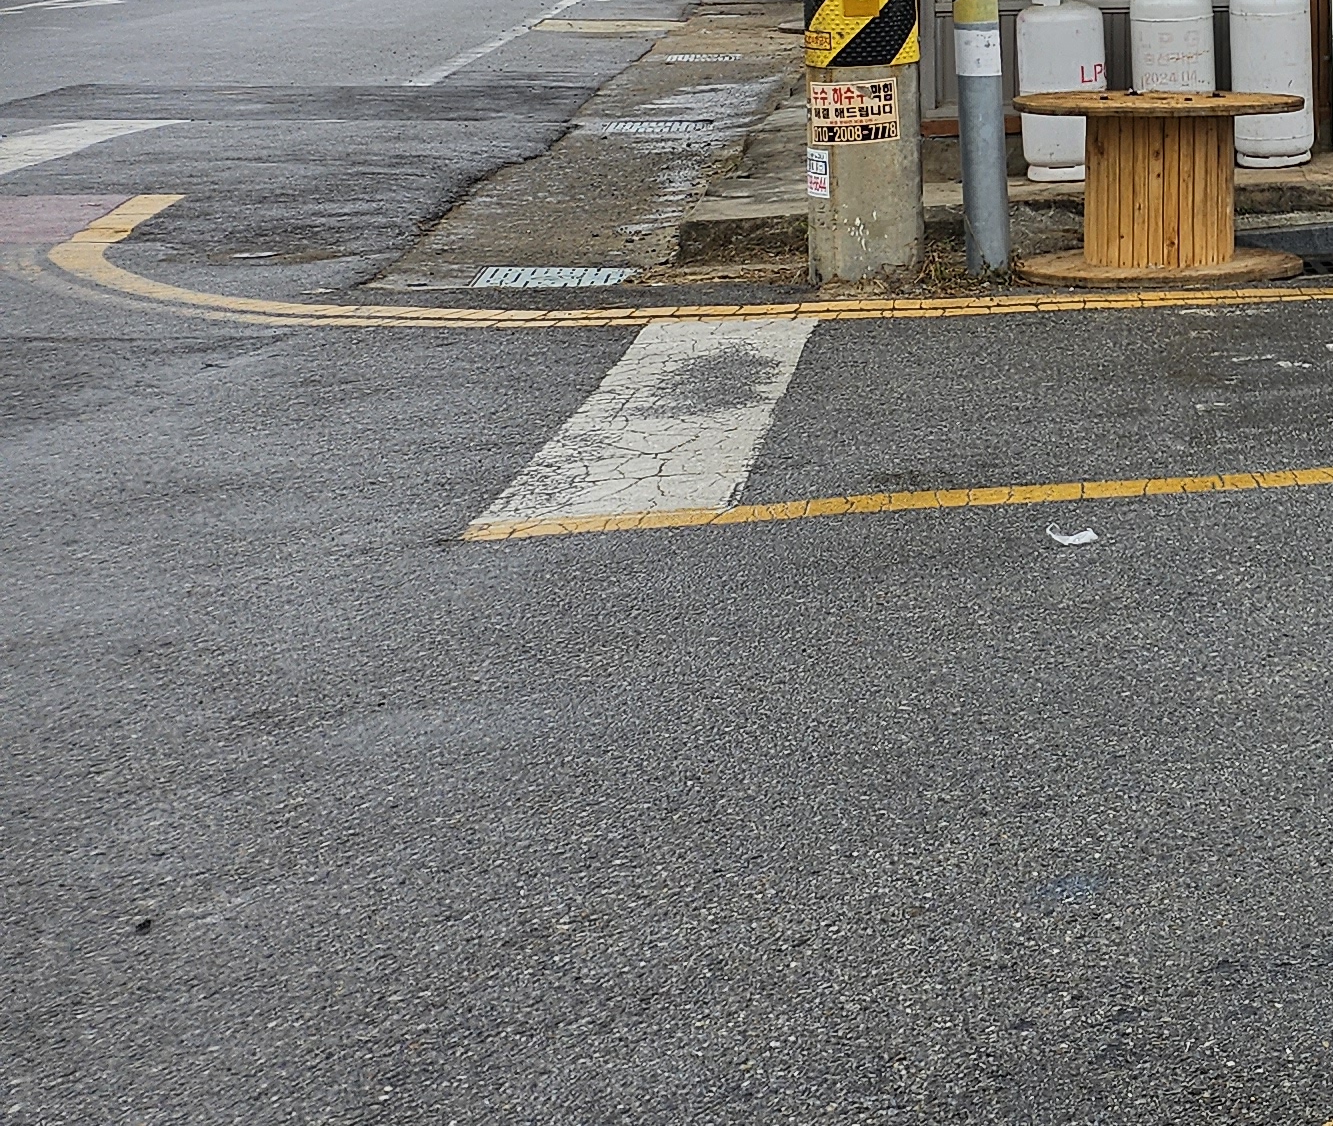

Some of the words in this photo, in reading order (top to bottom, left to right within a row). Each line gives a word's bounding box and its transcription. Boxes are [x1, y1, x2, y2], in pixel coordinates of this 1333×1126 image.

[1080, 64, 1107, 84] LP
[870, 83, 893, 102] 막힘
[834, 103, 893, 119] 해드립니다
[814, 121, 897, 142] 010-2008-7778
